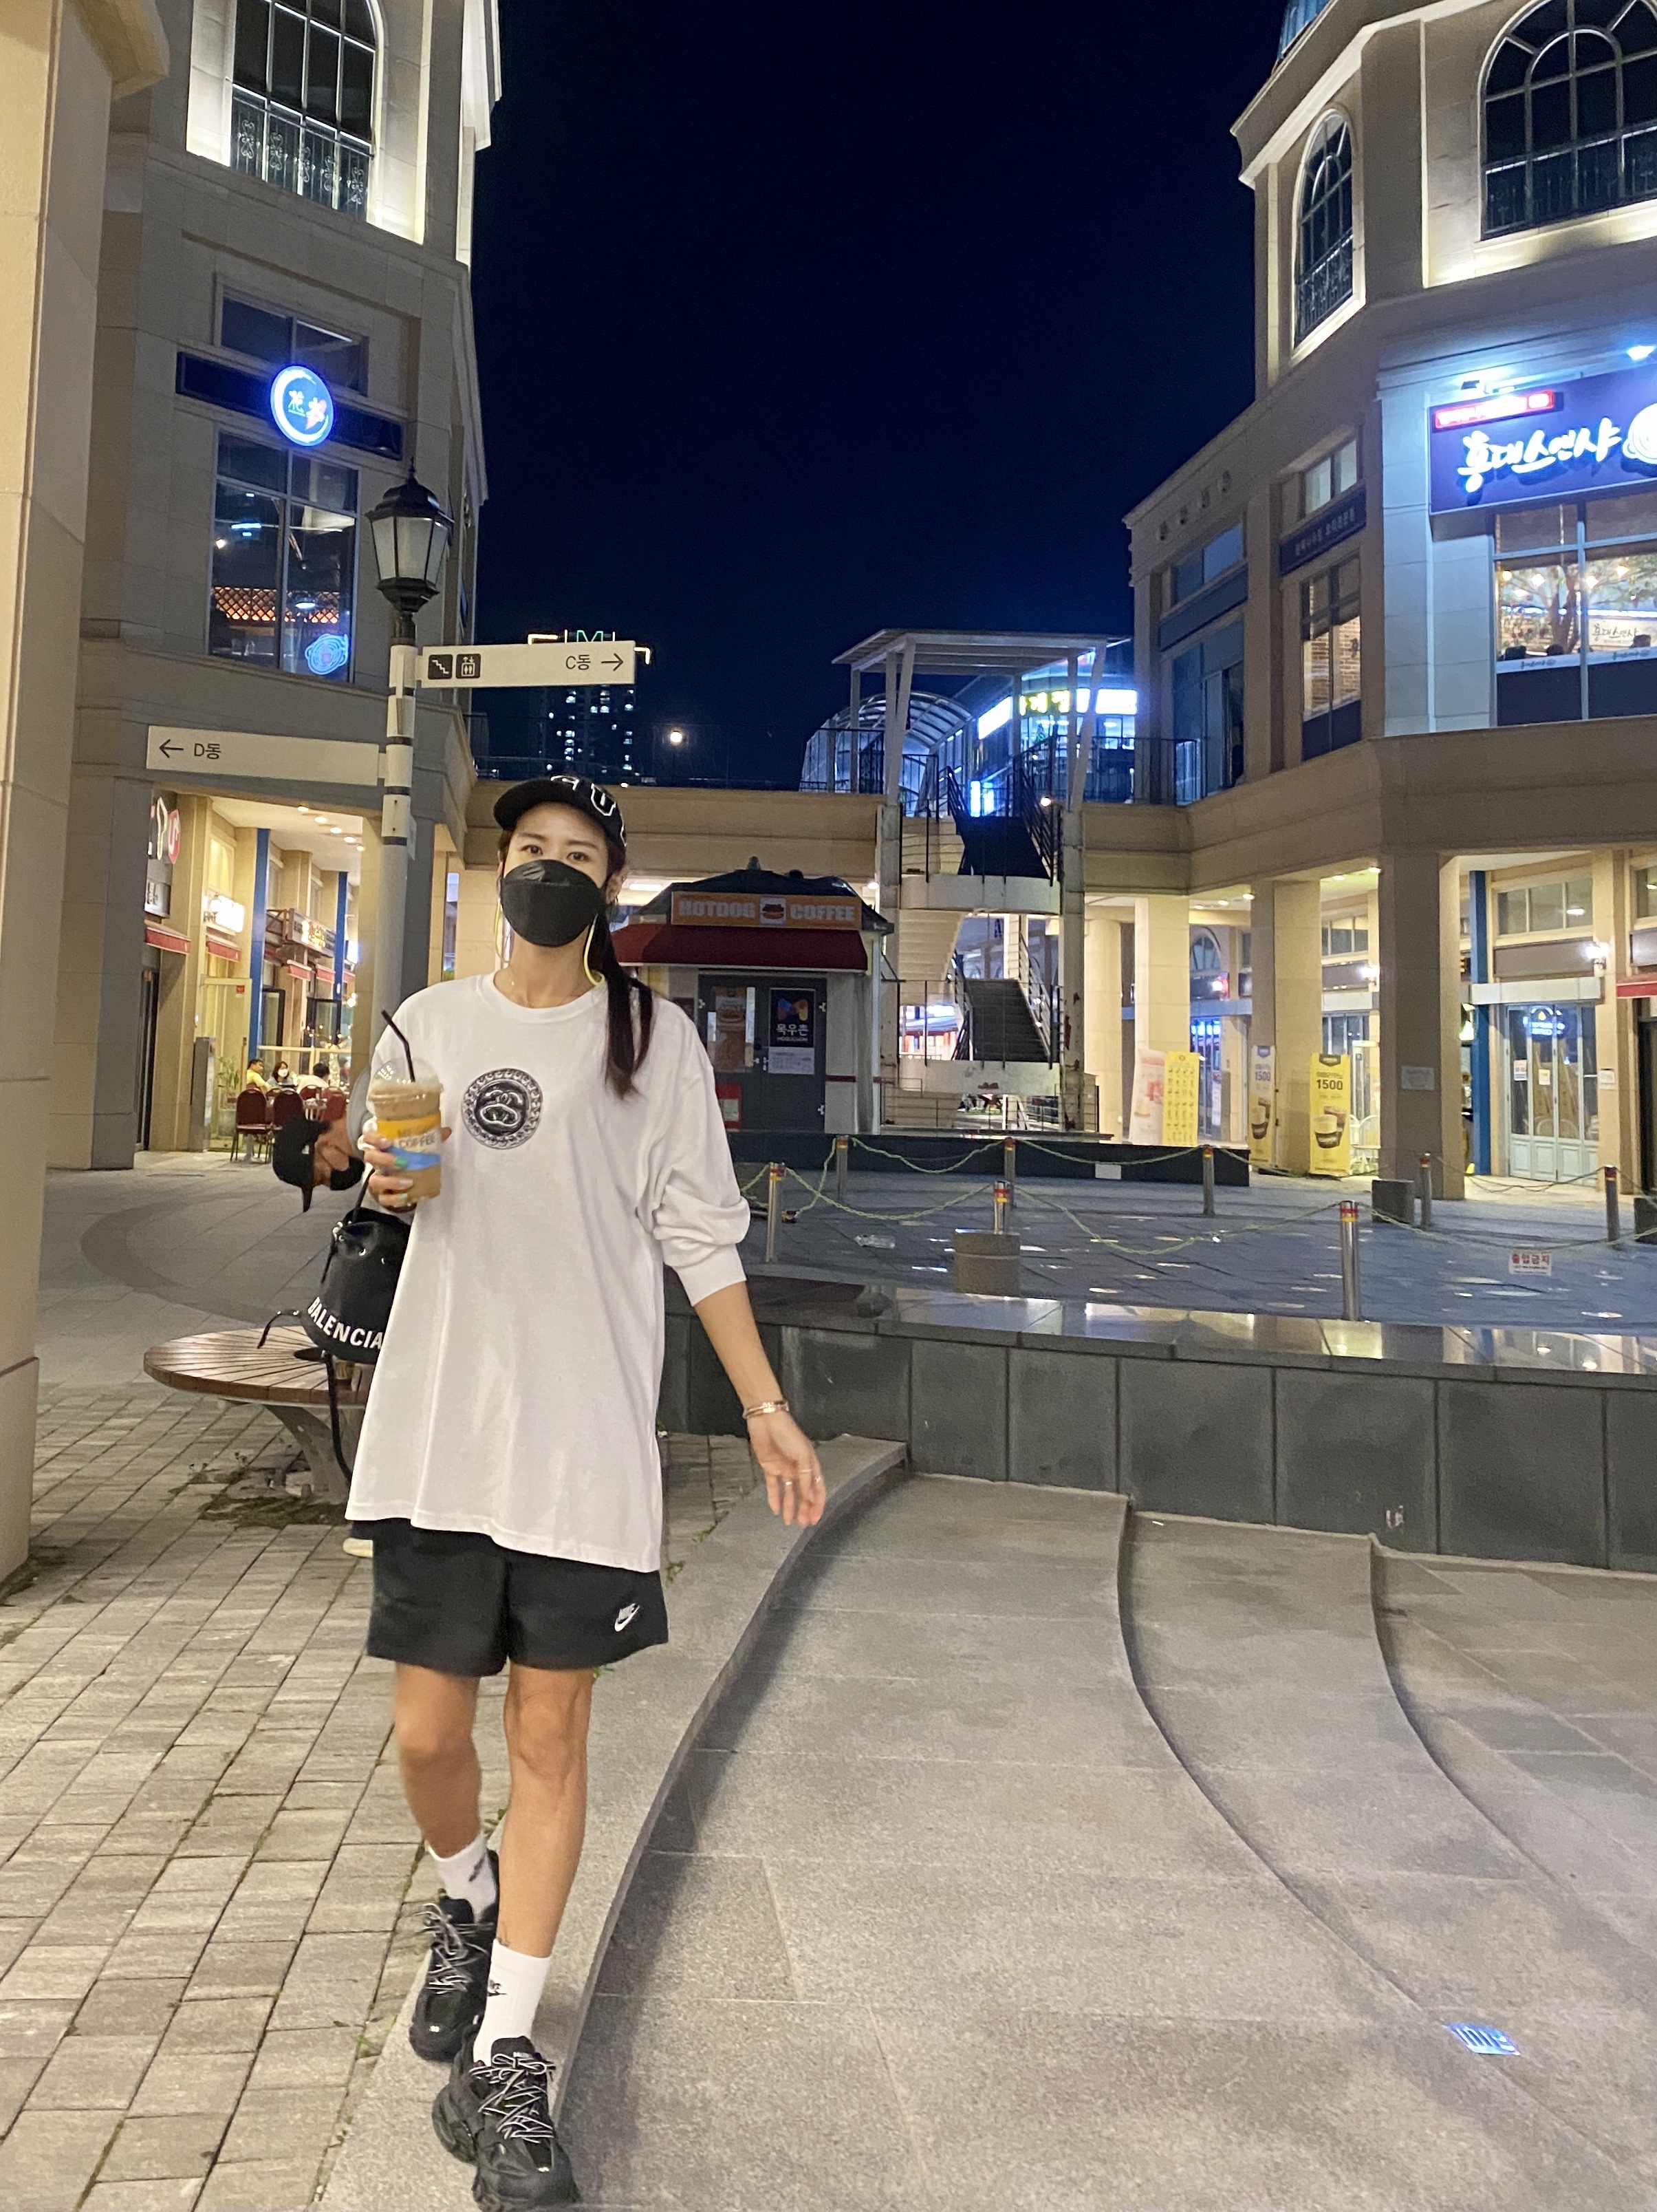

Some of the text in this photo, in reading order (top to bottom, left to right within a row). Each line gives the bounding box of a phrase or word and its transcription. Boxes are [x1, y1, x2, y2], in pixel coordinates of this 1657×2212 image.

[565, 654, 591, 670] C동
[194, 743, 221, 760] D동
[679, 900, 856, 921] HOTDOG COFFEE
[1317, 1079, 1343, 1091] 1500
[1512, 1254, 1550, 1265] 출입금지
[307, 1296, 384, 1349] BALENCIA
